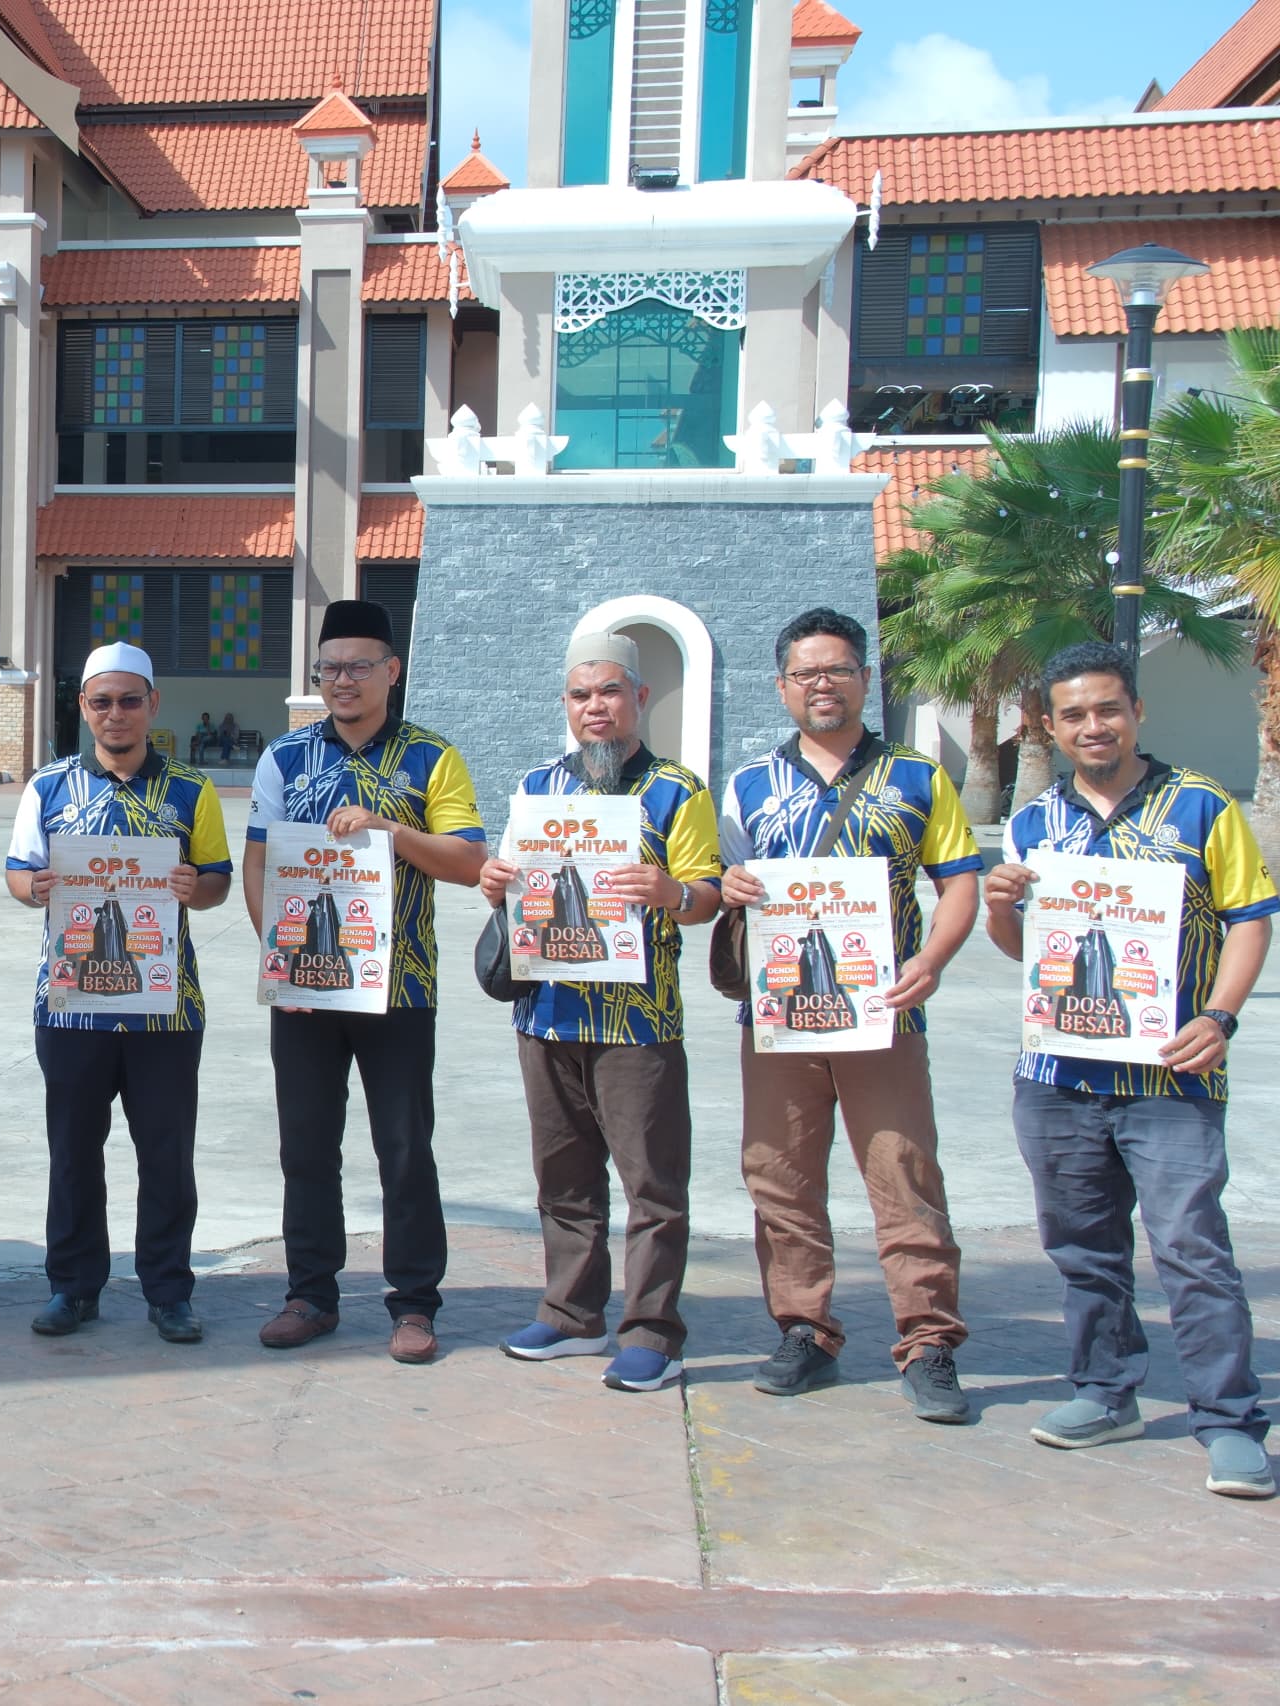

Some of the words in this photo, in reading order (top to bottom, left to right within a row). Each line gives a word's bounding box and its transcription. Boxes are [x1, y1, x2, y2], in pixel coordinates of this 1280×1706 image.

[544, 818, 598, 839] OPS
[516, 839, 566, 852] SUPIK
[575, 839, 627, 855] HITAM
[305, 848, 355, 867] OPS
[89, 857, 141, 875] OPS
[62, 875, 110, 887] SUPIK
[119, 877, 167, 891] HITAM
[277, 866, 325, 880] SUPIK
[333, 869, 381, 884] HITAM
[788, 879, 846, 901] OPS
[1072, 880, 1133, 905] OPS
[760, 904, 813, 917] SUPIK
[822, 900, 877, 917] HITAM
[1039, 897, 1097, 915] SUPIK
[1106, 905, 1165, 924] HITAM
[341, 929, 372, 937] PENJARA
[550, 928, 598, 942] DOSA
[547, 944, 604, 958] BESAR
[89, 961, 133, 975] DOSA
[301, 954, 345, 970] DOSA
[837, 965, 873, 973] PENJARA
[1041, 964, 1070, 972] DENDA
[84, 976, 138, 991] BESAR
[296, 970, 350, 987] BESAR
[767, 976, 799, 984] RM3000
[845, 974, 872, 982] TAHUN
[1040, 974, 1072, 982] RM3000
[1115, 970, 1154, 981] PENJARA
[1123, 981, 1152, 991] TAHUN
[796, 994, 847, 1009] DOSA
[1067, 996, 1120, 1016] DOSA
[792, 1012, 853, 1028] BESAR
[1061, 1014, 1125, 1035] BESAR
